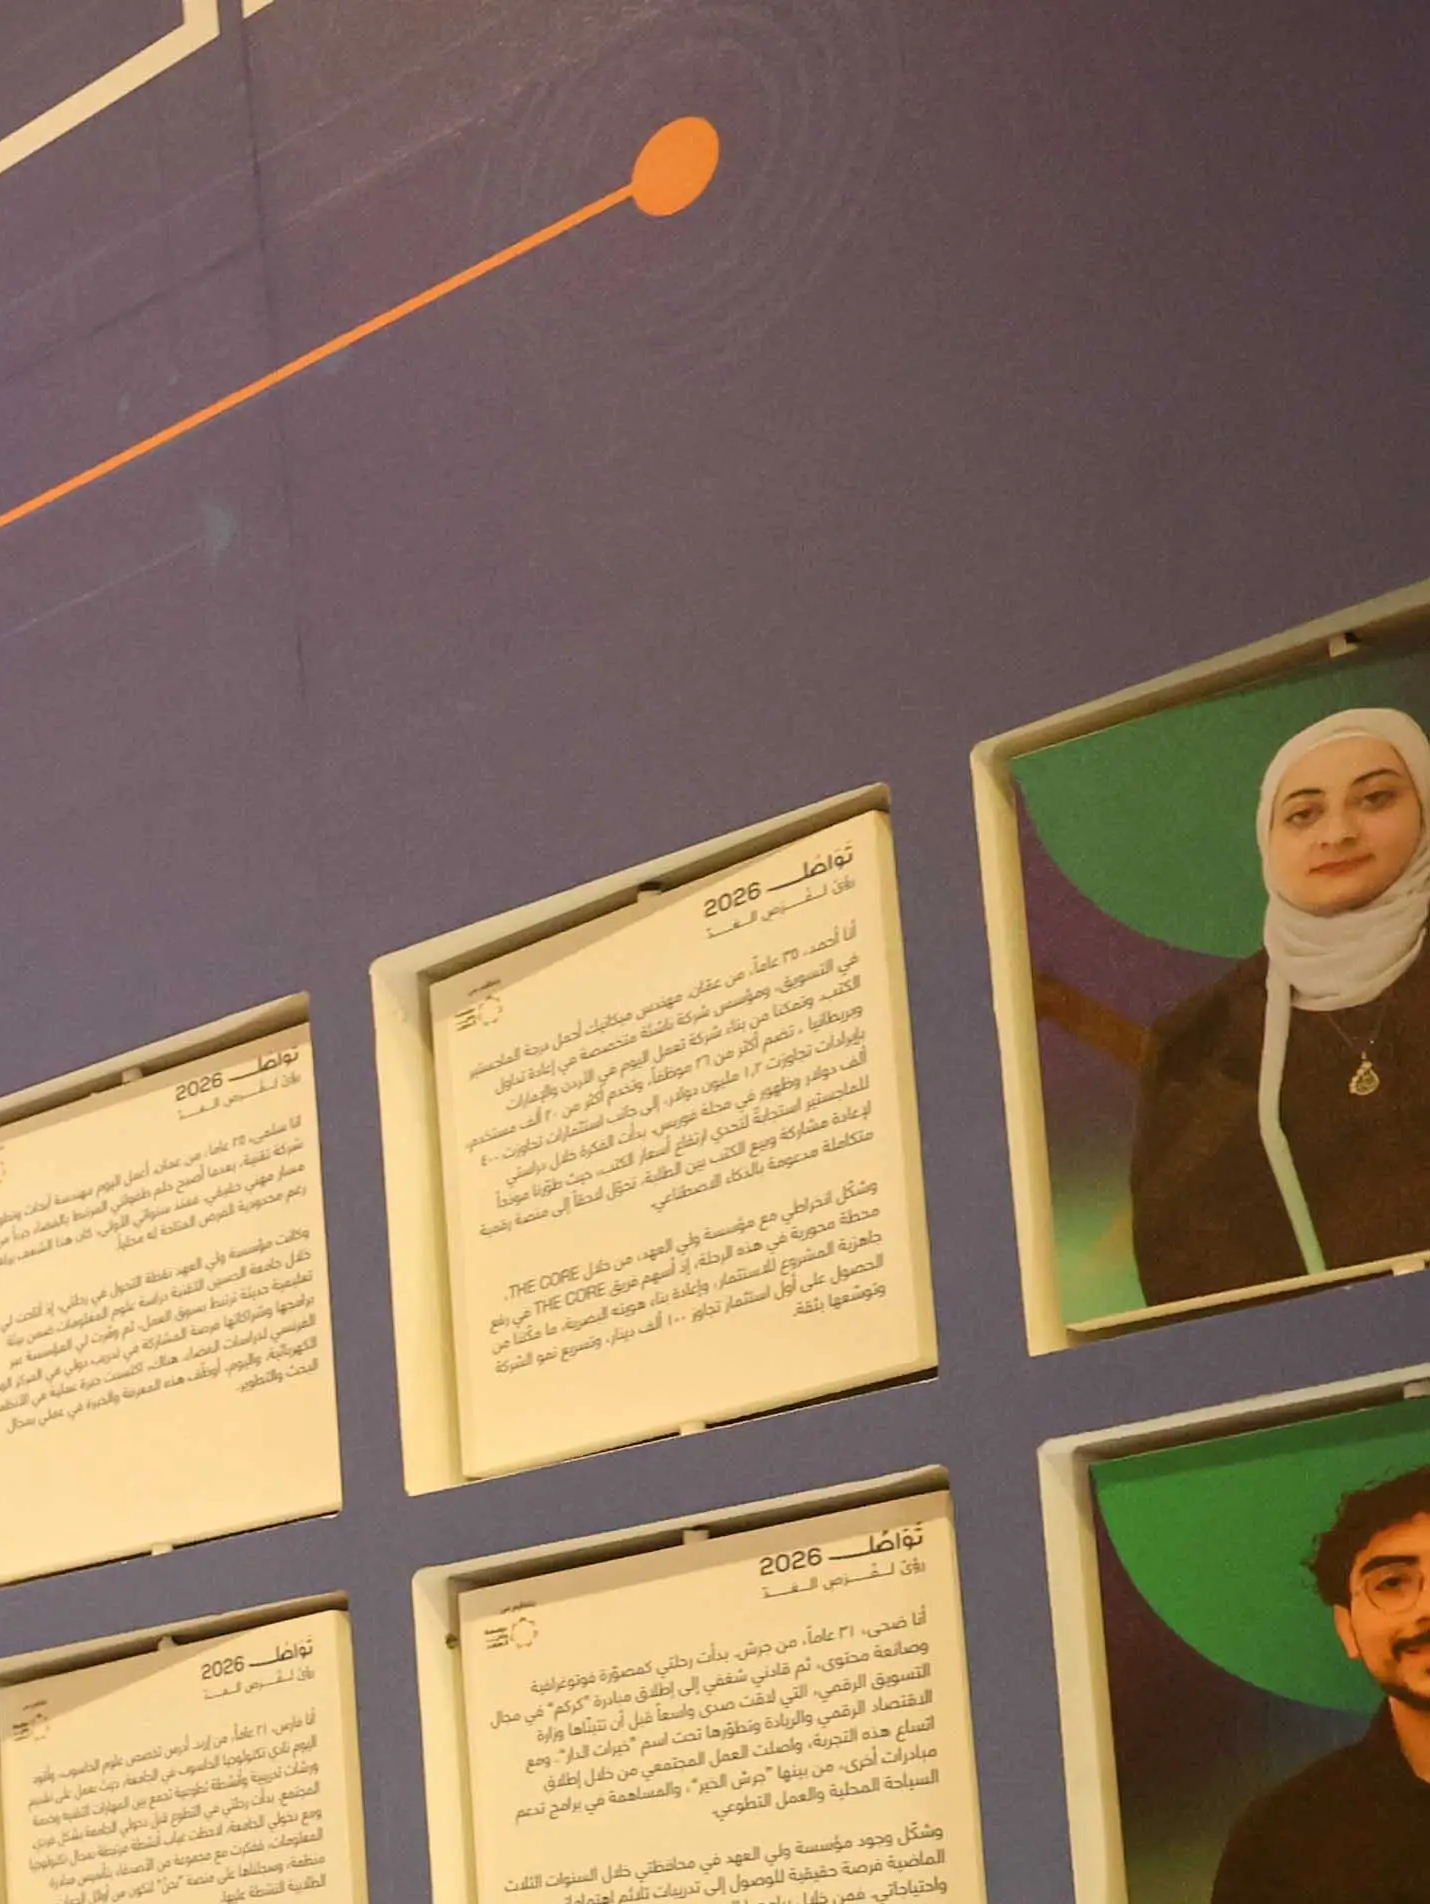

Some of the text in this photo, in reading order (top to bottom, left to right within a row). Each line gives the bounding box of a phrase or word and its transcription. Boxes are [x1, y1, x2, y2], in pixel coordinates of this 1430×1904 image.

[702, 880, 762, 918] 2026
[175, 1071, 224, 1101] 2026
[504, 1278, 536, 1300] THE
[532, 1294, 561, 1314] THE
[758, 1546, 823, 1576] 2026
[201, 1655, 246, 1680] 2026
